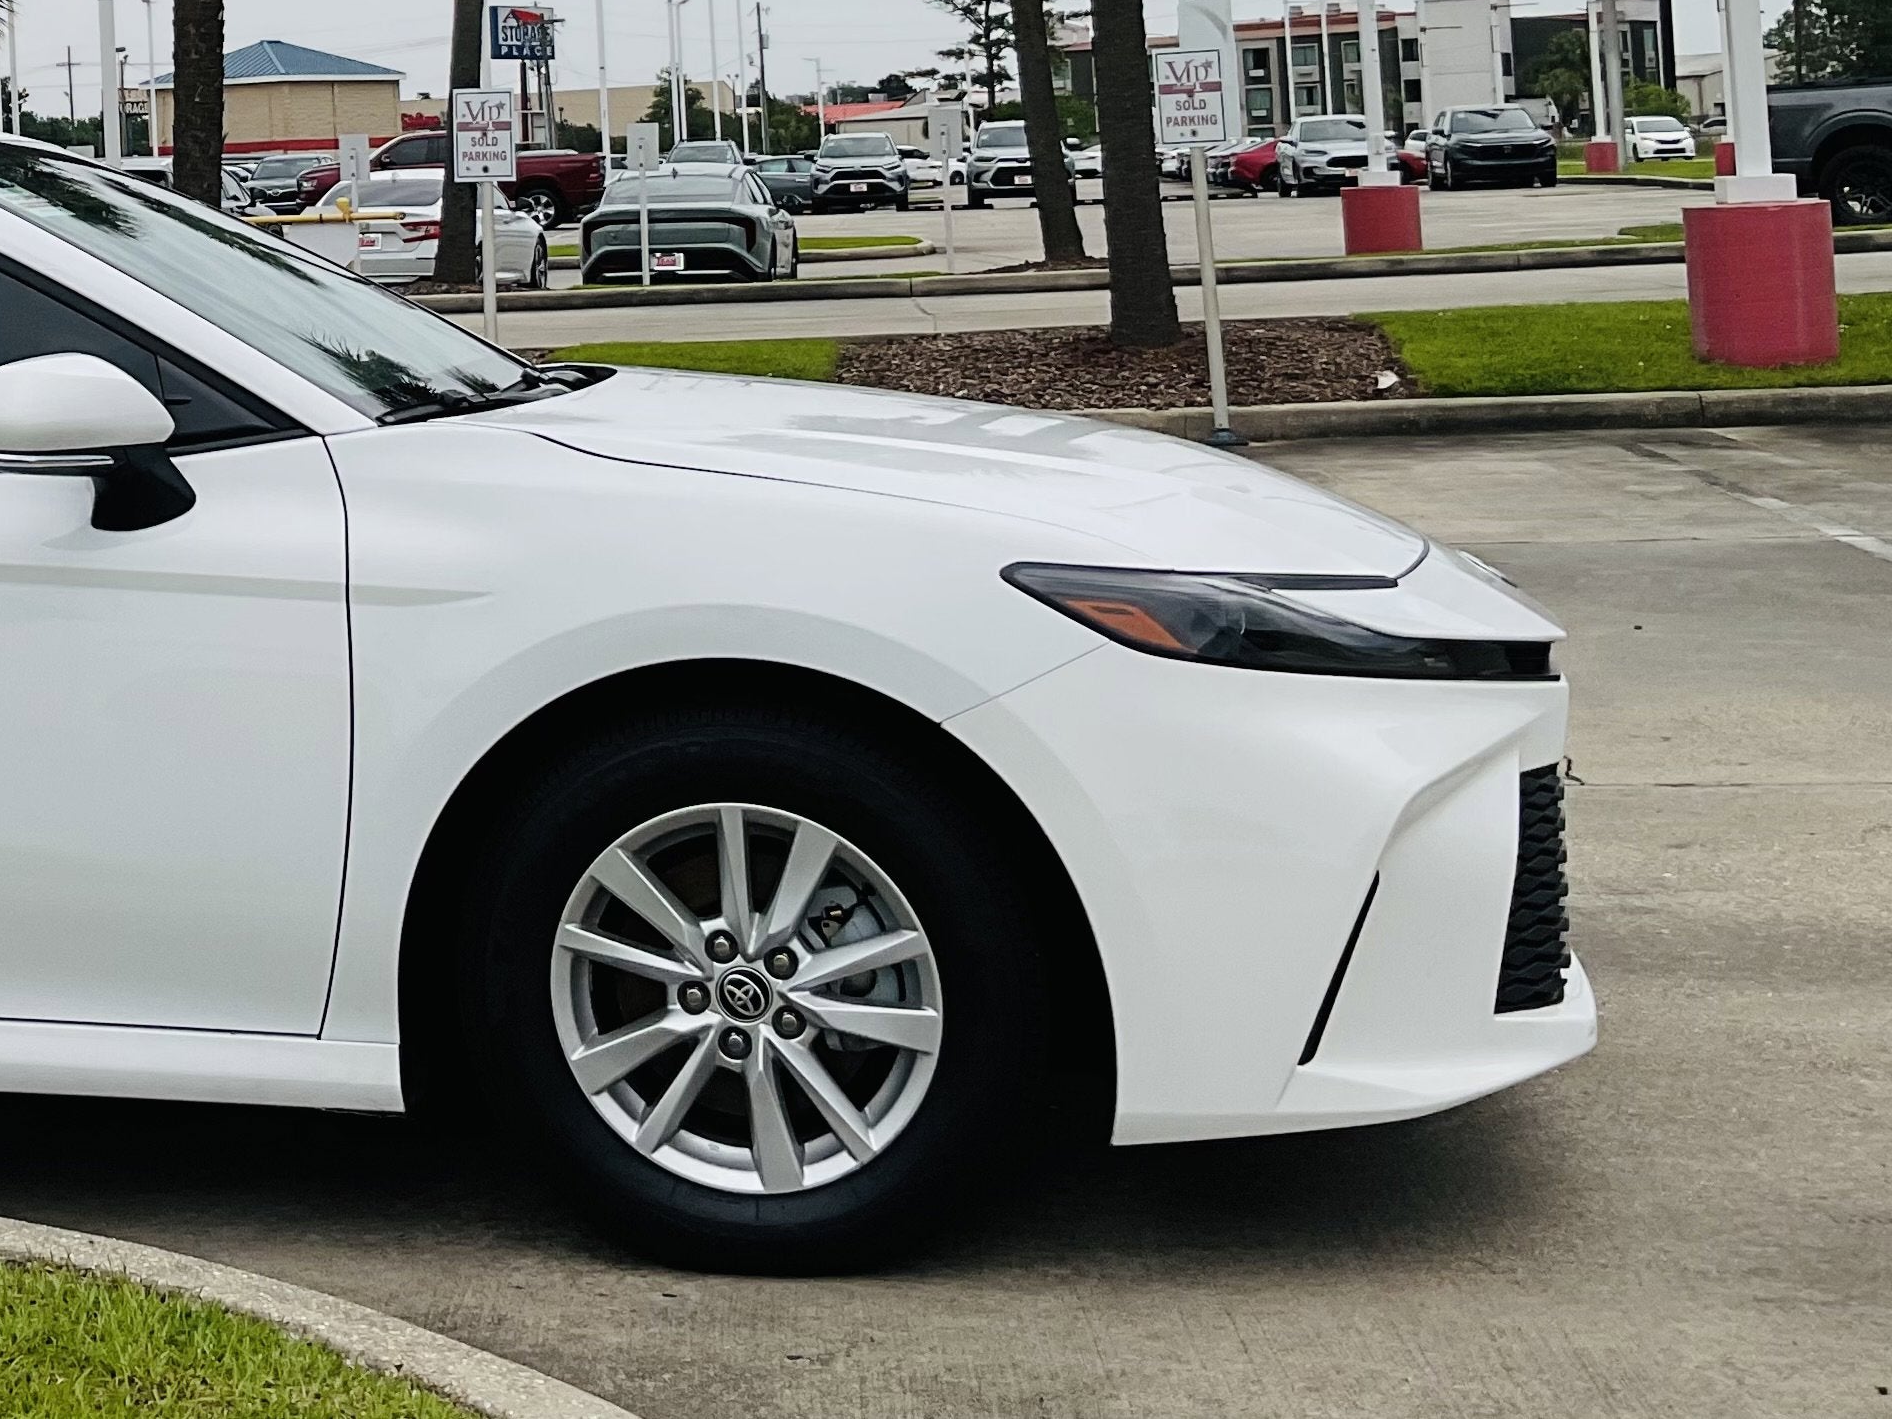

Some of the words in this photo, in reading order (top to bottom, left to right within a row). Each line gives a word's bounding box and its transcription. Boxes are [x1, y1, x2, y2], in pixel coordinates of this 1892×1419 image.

[502, 26, 552, 44] STORA
[501, 45, 553, 56] PLACE
[1175, 98, 1207, 112] SOLD
[1166, 114, 1218, 127] PARKING
[471, 136, 499, 147] SOLD
[462, 151, 508, 161] PARKING
